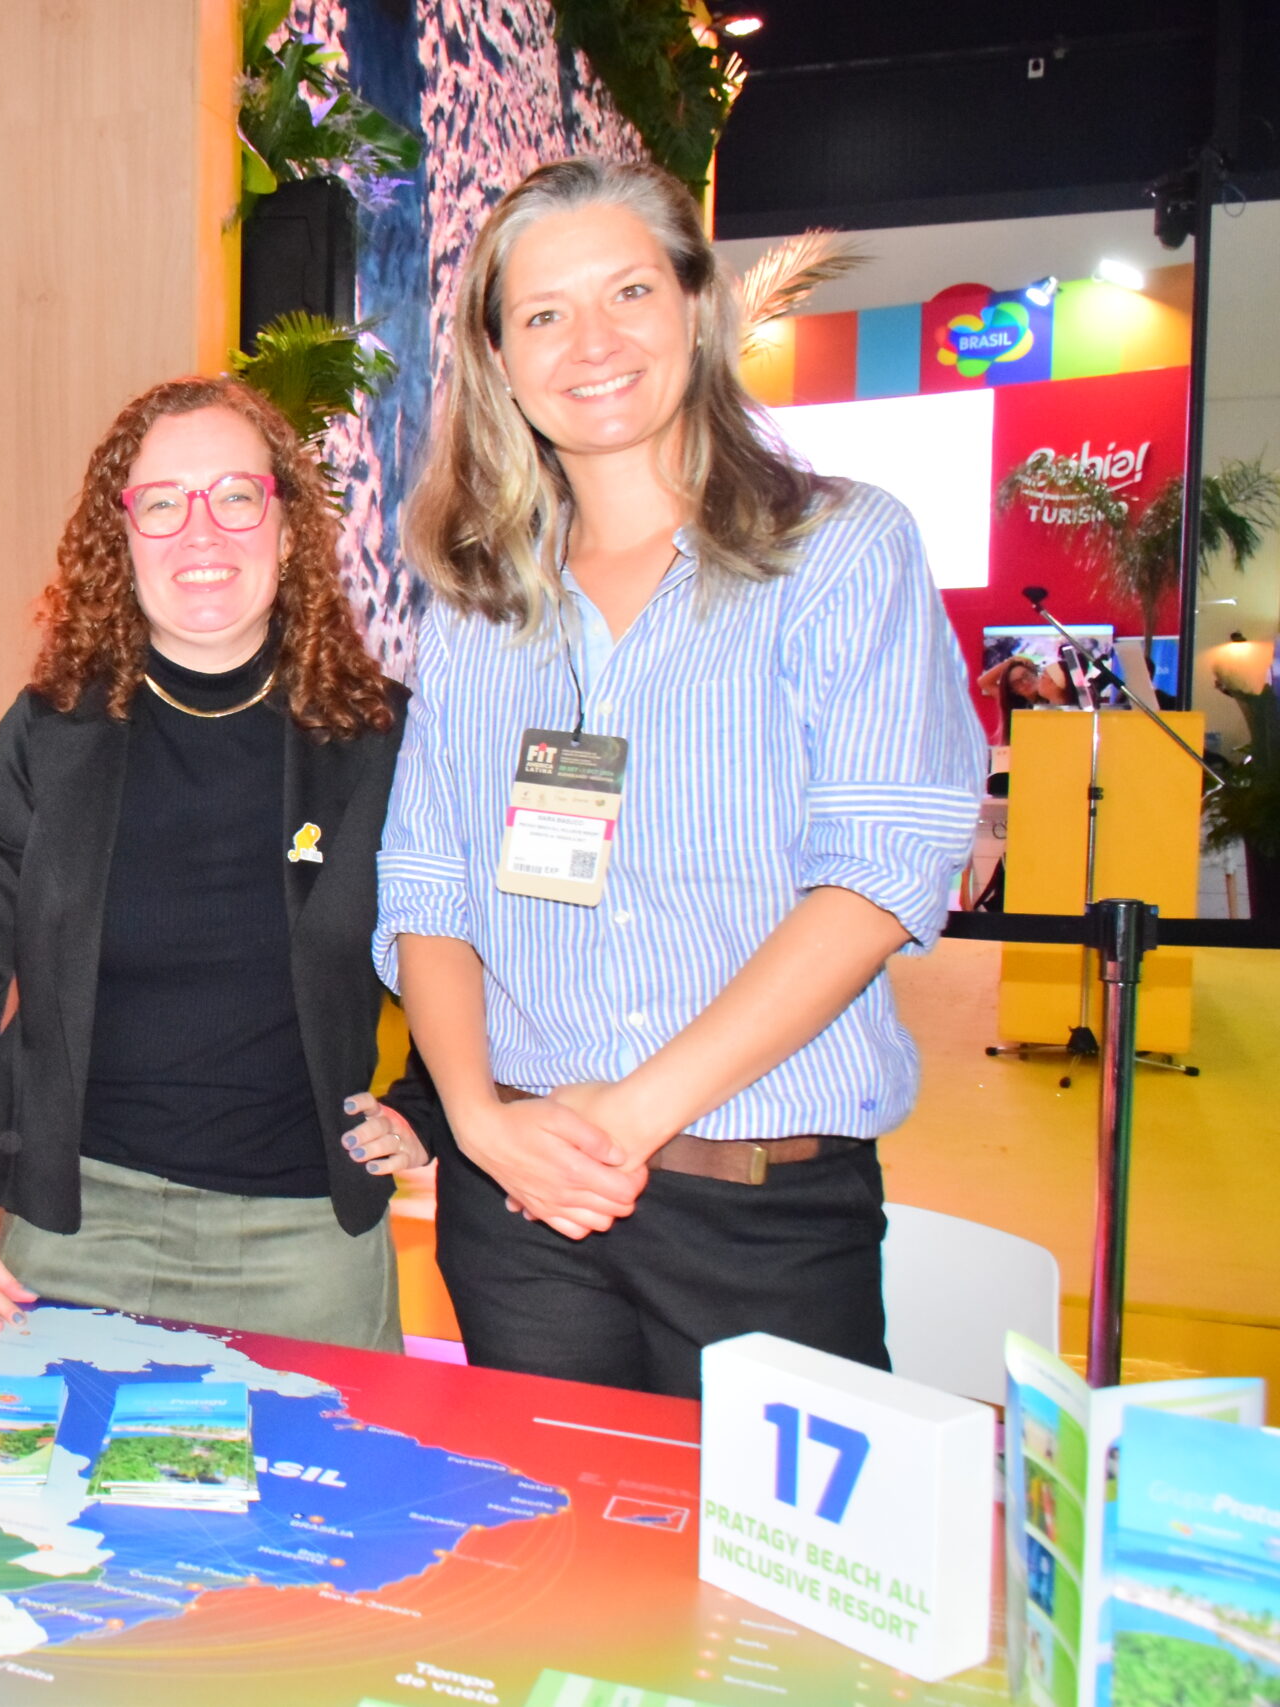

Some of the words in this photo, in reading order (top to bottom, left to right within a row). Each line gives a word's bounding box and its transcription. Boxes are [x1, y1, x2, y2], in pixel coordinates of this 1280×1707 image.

[958, 331, 1012, 351] BRASIL
[253, 1455, 347, 1488] ASIL
[763, 1401, 871, 1525] 17
[704, 1499, 800, 1558] PRATAGY
[805, 1542, 882, 1595] BEACH
[887, 1576, 932, 1615] ALL
[712, 1535, 821, 1603] INCLUSIVE
[828, 1583, 919, 1644] RESORT
[395, 1673, 427, 1688] de
[431, 1681, 499, 1705] vuelo
[416, 1661, 495, 1690] Tiempo
